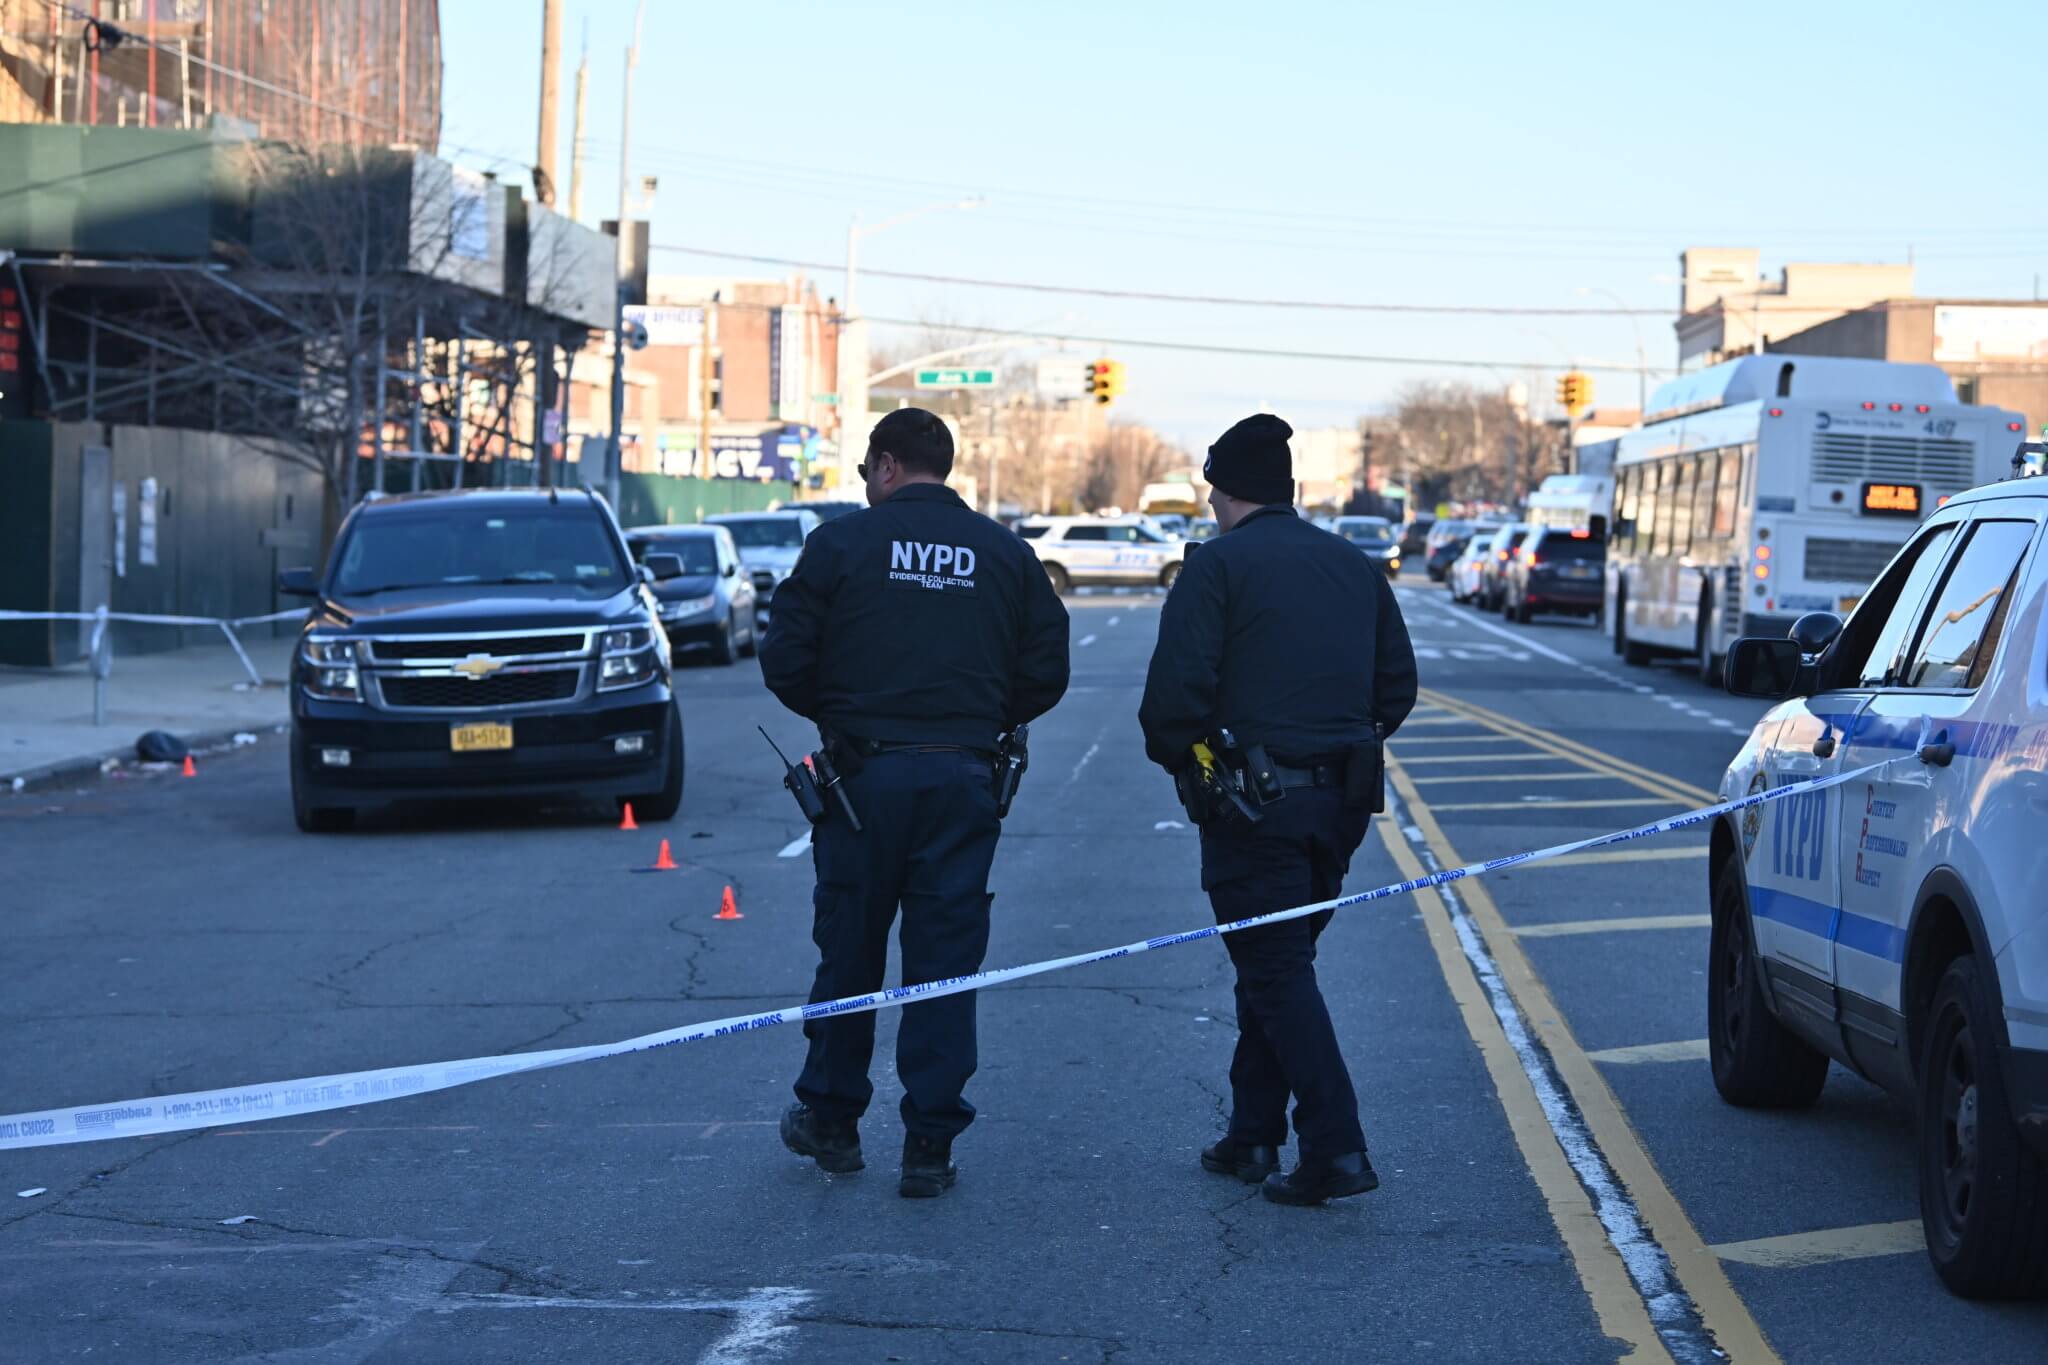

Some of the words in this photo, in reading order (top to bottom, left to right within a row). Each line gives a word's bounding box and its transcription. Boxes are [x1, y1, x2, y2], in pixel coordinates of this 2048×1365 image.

[891, 540, 976, 577] NYPD
[889, 571, 927, 582] EVIDENCE
[927, 575, 975, 588] COLLECTION
[920, 581, 944, 590] TEAM
[1773, 773, 1827, 881] NYPD
[751, 1012, 784, 1030] CROSS
